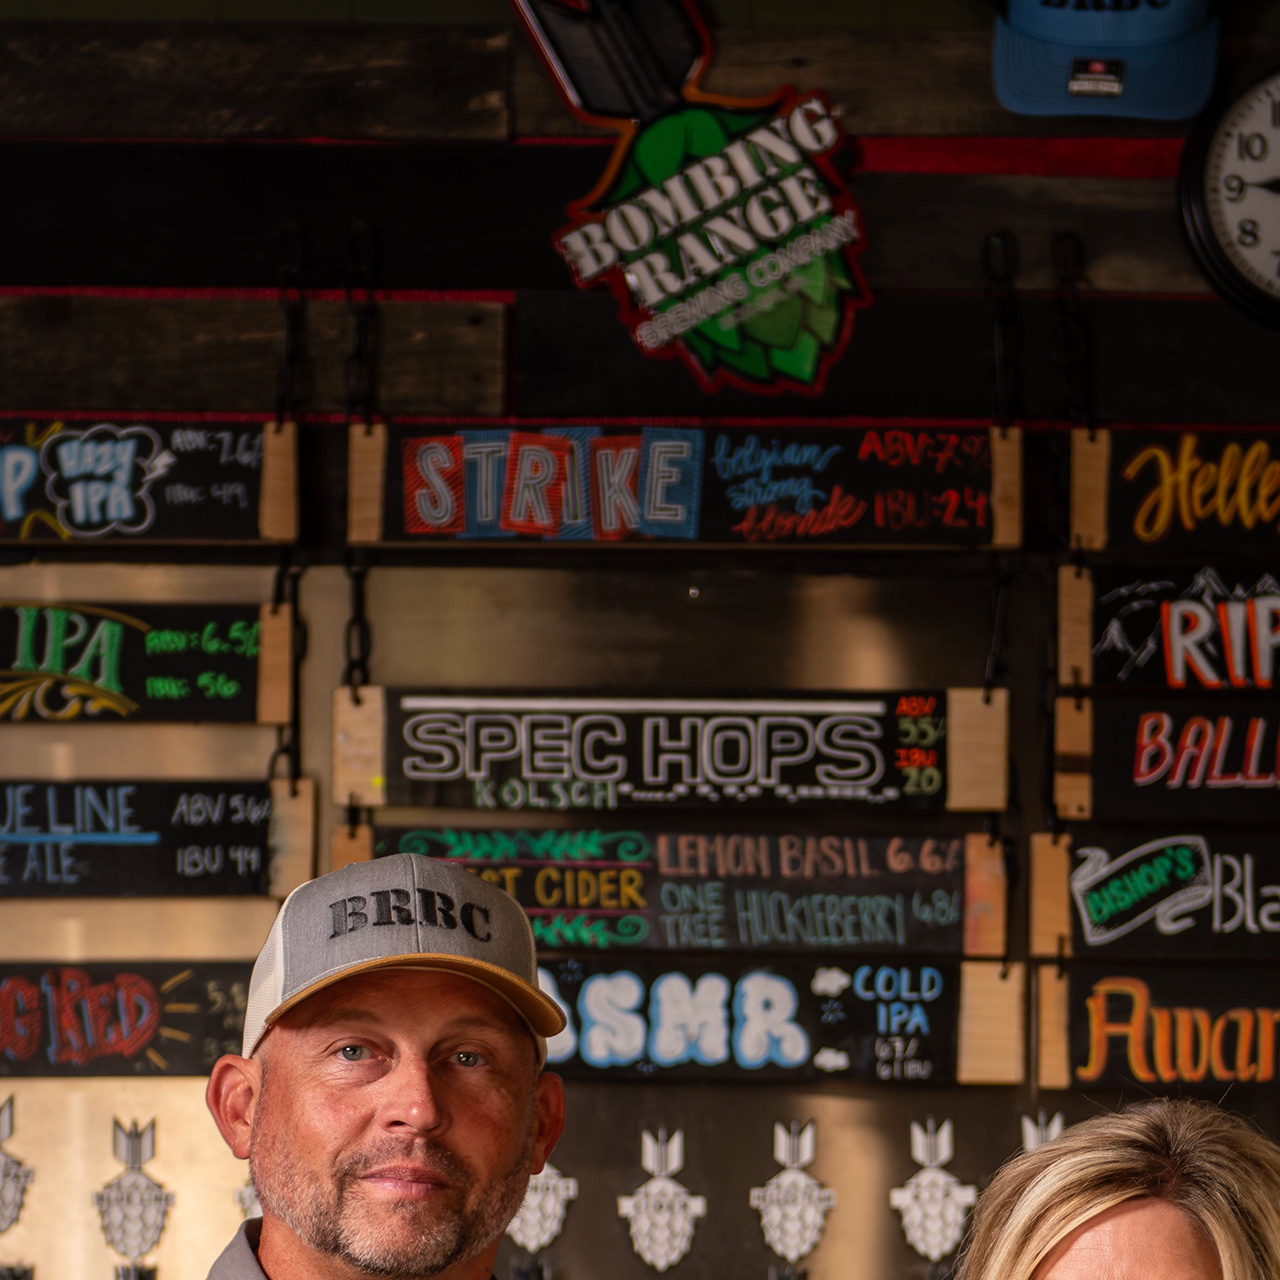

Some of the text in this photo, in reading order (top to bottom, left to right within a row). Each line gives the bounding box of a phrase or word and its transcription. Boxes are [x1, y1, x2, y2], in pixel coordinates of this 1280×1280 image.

[1238, 132, 1267, 160] 10
[560, 97, 840, 282] BOMBING
[1224, 174, 1244, 202] 9
[624, 166, 833, 308] RANGE
[1237, 218, 1260, 247] 8
[636, 270, 750, 350] BREWING
[745, 208, 861, 288] COMPANY
[56, 438, 138, 486] HAZY
[710, 434, 844, 482] belgian
[70, 478, 136, 526] IPA
[414, 440, 692, 532] STRIKE
[725, 475, 828, 516] strong
[730, 484, 868, 543] blonde
[14, 606, 124, 694] IPA
[895, 695, 937, 715] ABV
[402, 714, 886, 787] SPEC HOPS
[894, 748, 938, 767] IBU
[472, 778, 618, 809] KOLSCH
[902, 767, 943, 795] 20
[48, 785, 143, 834] LINE
[172, 793, 225, 826] ABV
[22, 844, 82, 884] ALE
[176, 846, 262, 878] IBU 44
[657, 834, 880, 879] LEMON BASIL
[534, 866, 648, 910] CIDER
[660, 882, 726, 914] ONE
[1088, 846, 1197, 924] BISHOP'S
[329, 888, 492, 942] BRBC
[659, 914, 728, 948] TREE
[734, 889, 906, 946] HUCKLEBERRY
[852, 964, 944, 1002] COLD
[46, 970, 161, 1064] RED
[876, 1001, 930, 1036] IPA
